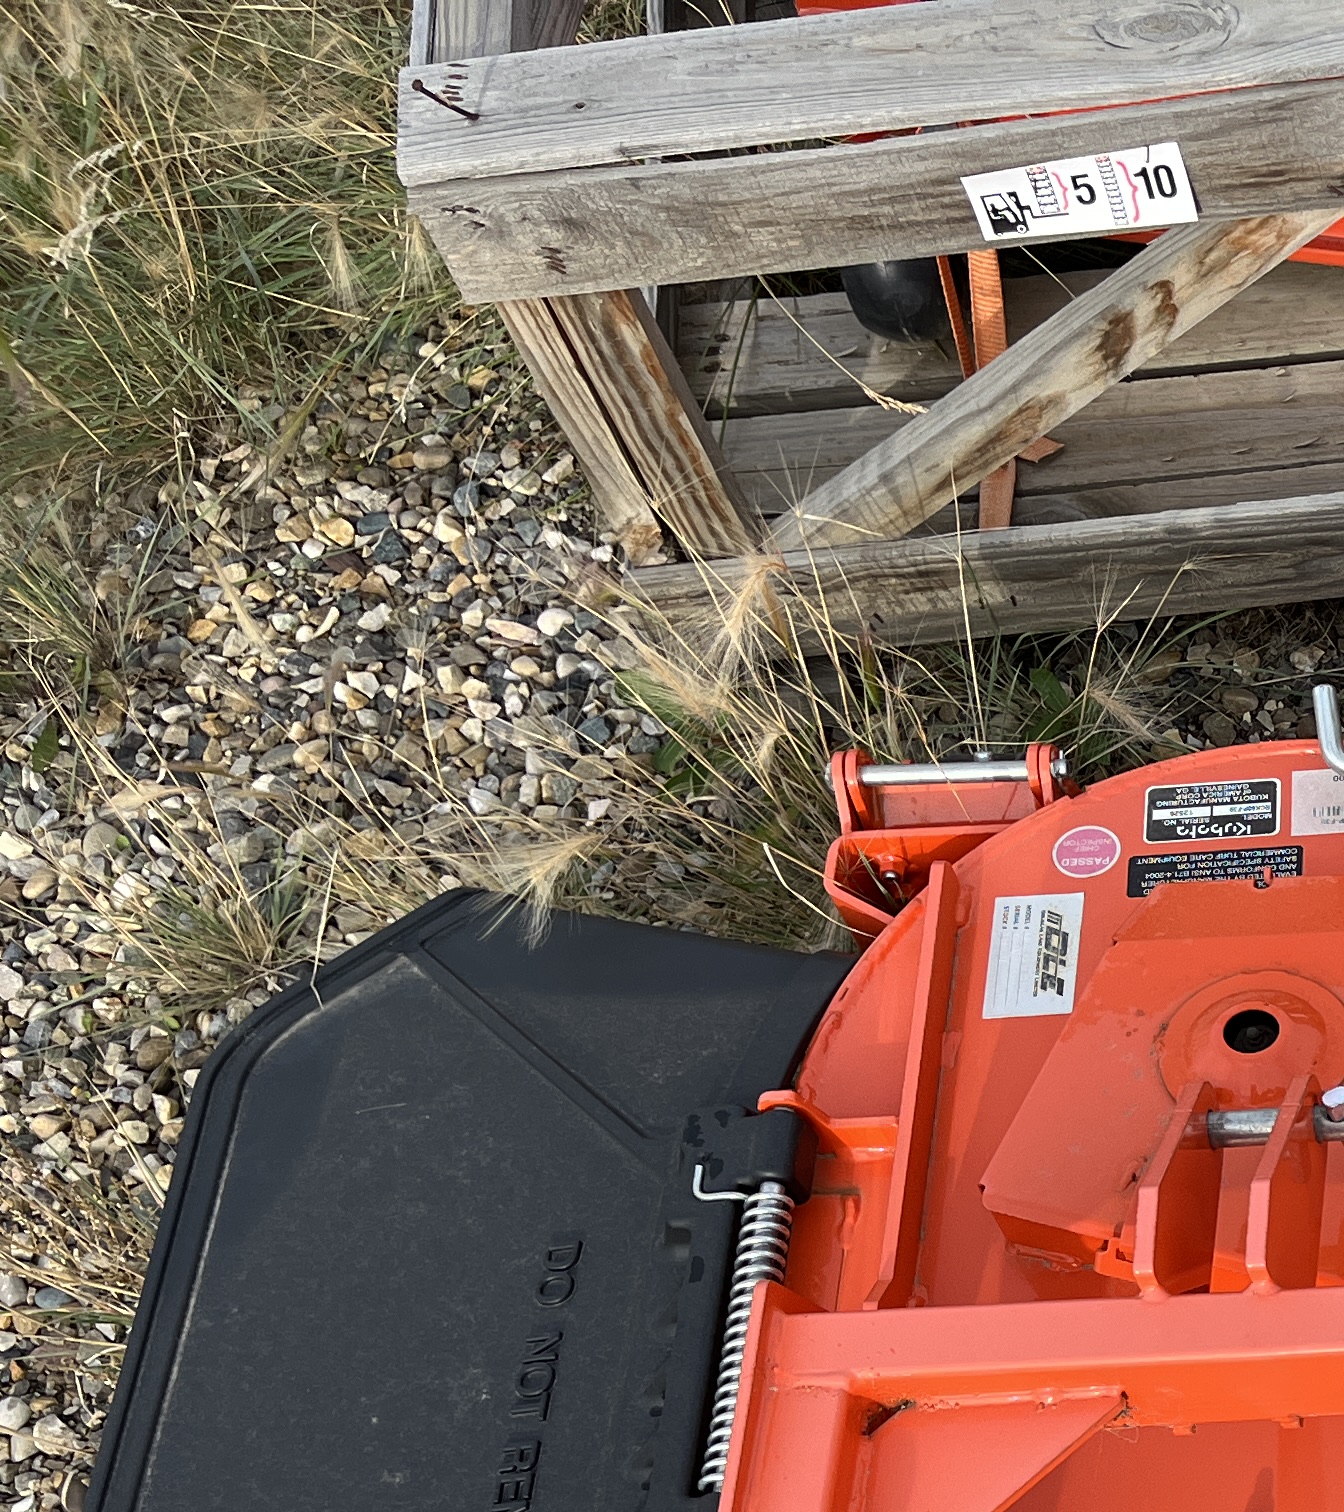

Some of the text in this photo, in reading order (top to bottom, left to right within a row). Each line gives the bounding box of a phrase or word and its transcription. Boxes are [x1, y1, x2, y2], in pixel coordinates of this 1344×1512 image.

[1133, 164, 1178, 200] 10
[1070, 174, 1097, 206] 5
[1175, 786, 1189, 794] GA
[1202, 788, 1241, 798] AMERICA
[1154, 793, 1268, 808] KUBOTA MANUFACTURING
[1178, 815, 1210, 825] SERIAL
[1242, 811, 1272, 821] MODEL
[1174, 819, 1251, 842] Kubota
[1060, 856, 1109, 866] PASSED
[1135, 847, 1297, 865] COMMERCIAL TURF CARE EQUIPMENT
[1175, 854, 1297, 870] SAFETY SPECIFICATION FOR
[1190, 868, 1211, 876] ANSI
[1226, 863, 1276, 875] CNFORMS
[1278, 862, 1297, 870] AND
[536, 1238, 585, 1308] DO
[509, 1330, 564, 1422] NOT
